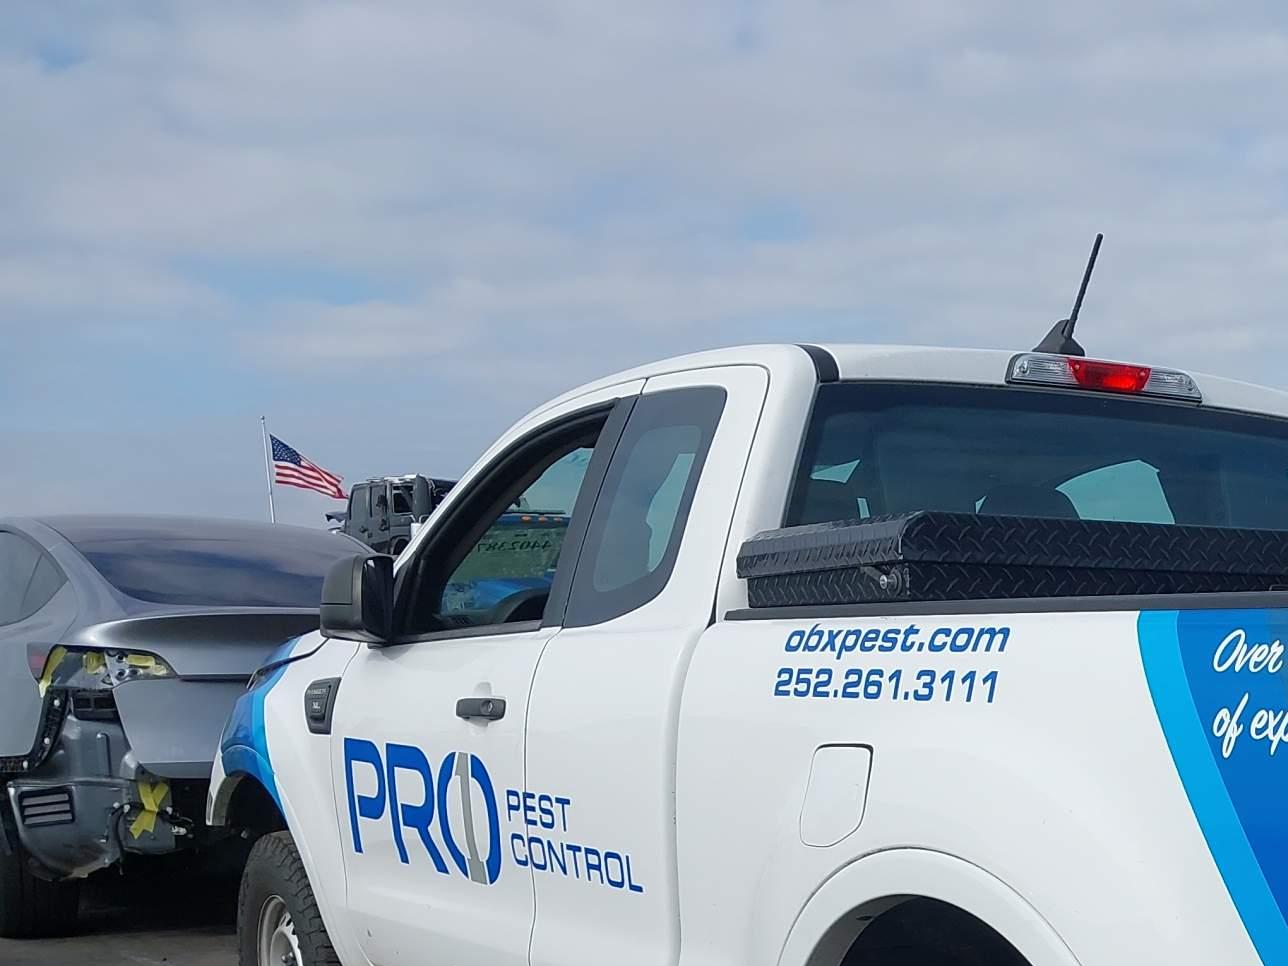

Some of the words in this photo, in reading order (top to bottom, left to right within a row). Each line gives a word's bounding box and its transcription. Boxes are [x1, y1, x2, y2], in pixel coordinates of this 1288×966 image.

[784, 623, 1011, 660] obxpest.com
[1213, 629, 1285, 673] Over
[774, 667, 999, 703] 252.261.3111
[1213, 692, 1249, 758] of
[506, 789, 571, 832] PEST
[511, 833, 644, 893] CONTROL
